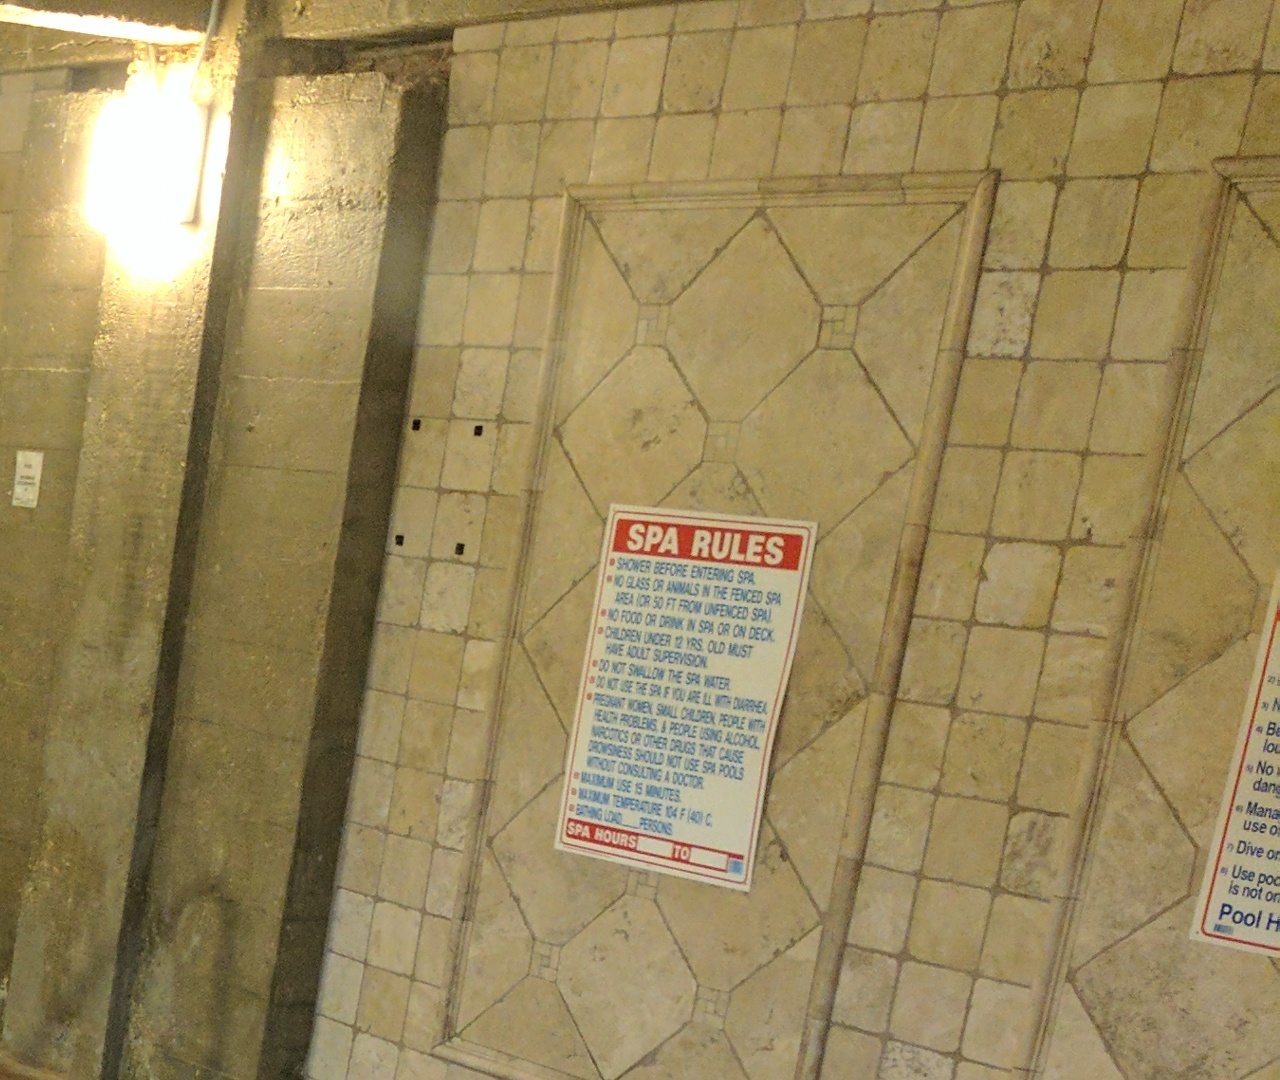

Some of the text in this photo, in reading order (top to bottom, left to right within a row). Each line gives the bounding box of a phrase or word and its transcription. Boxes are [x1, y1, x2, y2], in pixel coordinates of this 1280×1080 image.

[627, 522, 785, 565] SPA RULES
[616, 557, 756, 584] SHOWER BEFORE ENTERING SPA.
[627, 576, 650, 590] GLASS
[666, 580, 699, 596] ANIMALS
[730, 587, 762, 603] FENCED
[765, 591, 781, 605] SPA
[615, 591, 633, 605] AREA
[679, 599, 701, 614] FROM
[704, 602, 748, 620] UNFENCED
[621, 610, 642, 624] FOOD
[659, 615, 684, 630] DRINK
[698, 620, 713, 634] SPA
[749, 627, 775, 642] DECK.
[605, 626, 641, 642] CHILDREN
[644, 631, 670, 647] UNDER
[707, 640, 724, 654] OLD
[727, 643, 753, 658] MUST
[605, 642, 623, 655] HAVE
[626, 645, 649, 659] ADULT
[628, 663, 664, 680] SWALLOW
[670, 687, 685, 701] YOU
[715, 694, 731, 708] WITH
[593, 693, 624, 709] PREGNANT
[656, 703, 678, 718] SMALL
[718, 713, 745, 729] PEOPLE
[748, 718, 765, 732] WITH
[594, 709, 617, 724] HEALTH
[669, 722, 696, 738] PEOPLE
[700, 727, 722, 743] USING
[591, 725, 628, 742] NARCOTICS
[643, 734, 667, 749] OTHER
[670, 739, 696, 755] DRUGS
[698, 744, 714, 758] THAT
[718, 747, 744, 763] CAUSE
[586, 755, 614, 772] WITHOUT
[617, 761, 662, 781] CONSULTING
[635, 748, 663, 765] SHOULD
[666, 754, 681, 768] NOT
[684, 757, 699, 772] USE
[718, 764, 743, 780] POOLS
[1256, 761, 1274, 776] No
[581, 771, 614, 789] MAXIMUM
[578, 787, 609, 805] MAXIMUM
[612, 794, 661, 815] TEMPERATURE
[1243, 820, 1267, 833] use
[566, 821, 689, 860] SPA HOURS TO
[1237, 840, 1264, 858] Dive
[1232, 865, 1255, 882] Use
[1229, 880, 1240, 895] is
[1242, 886, 1263, 900] not
[1218, 903, 1262, 928] Pool
